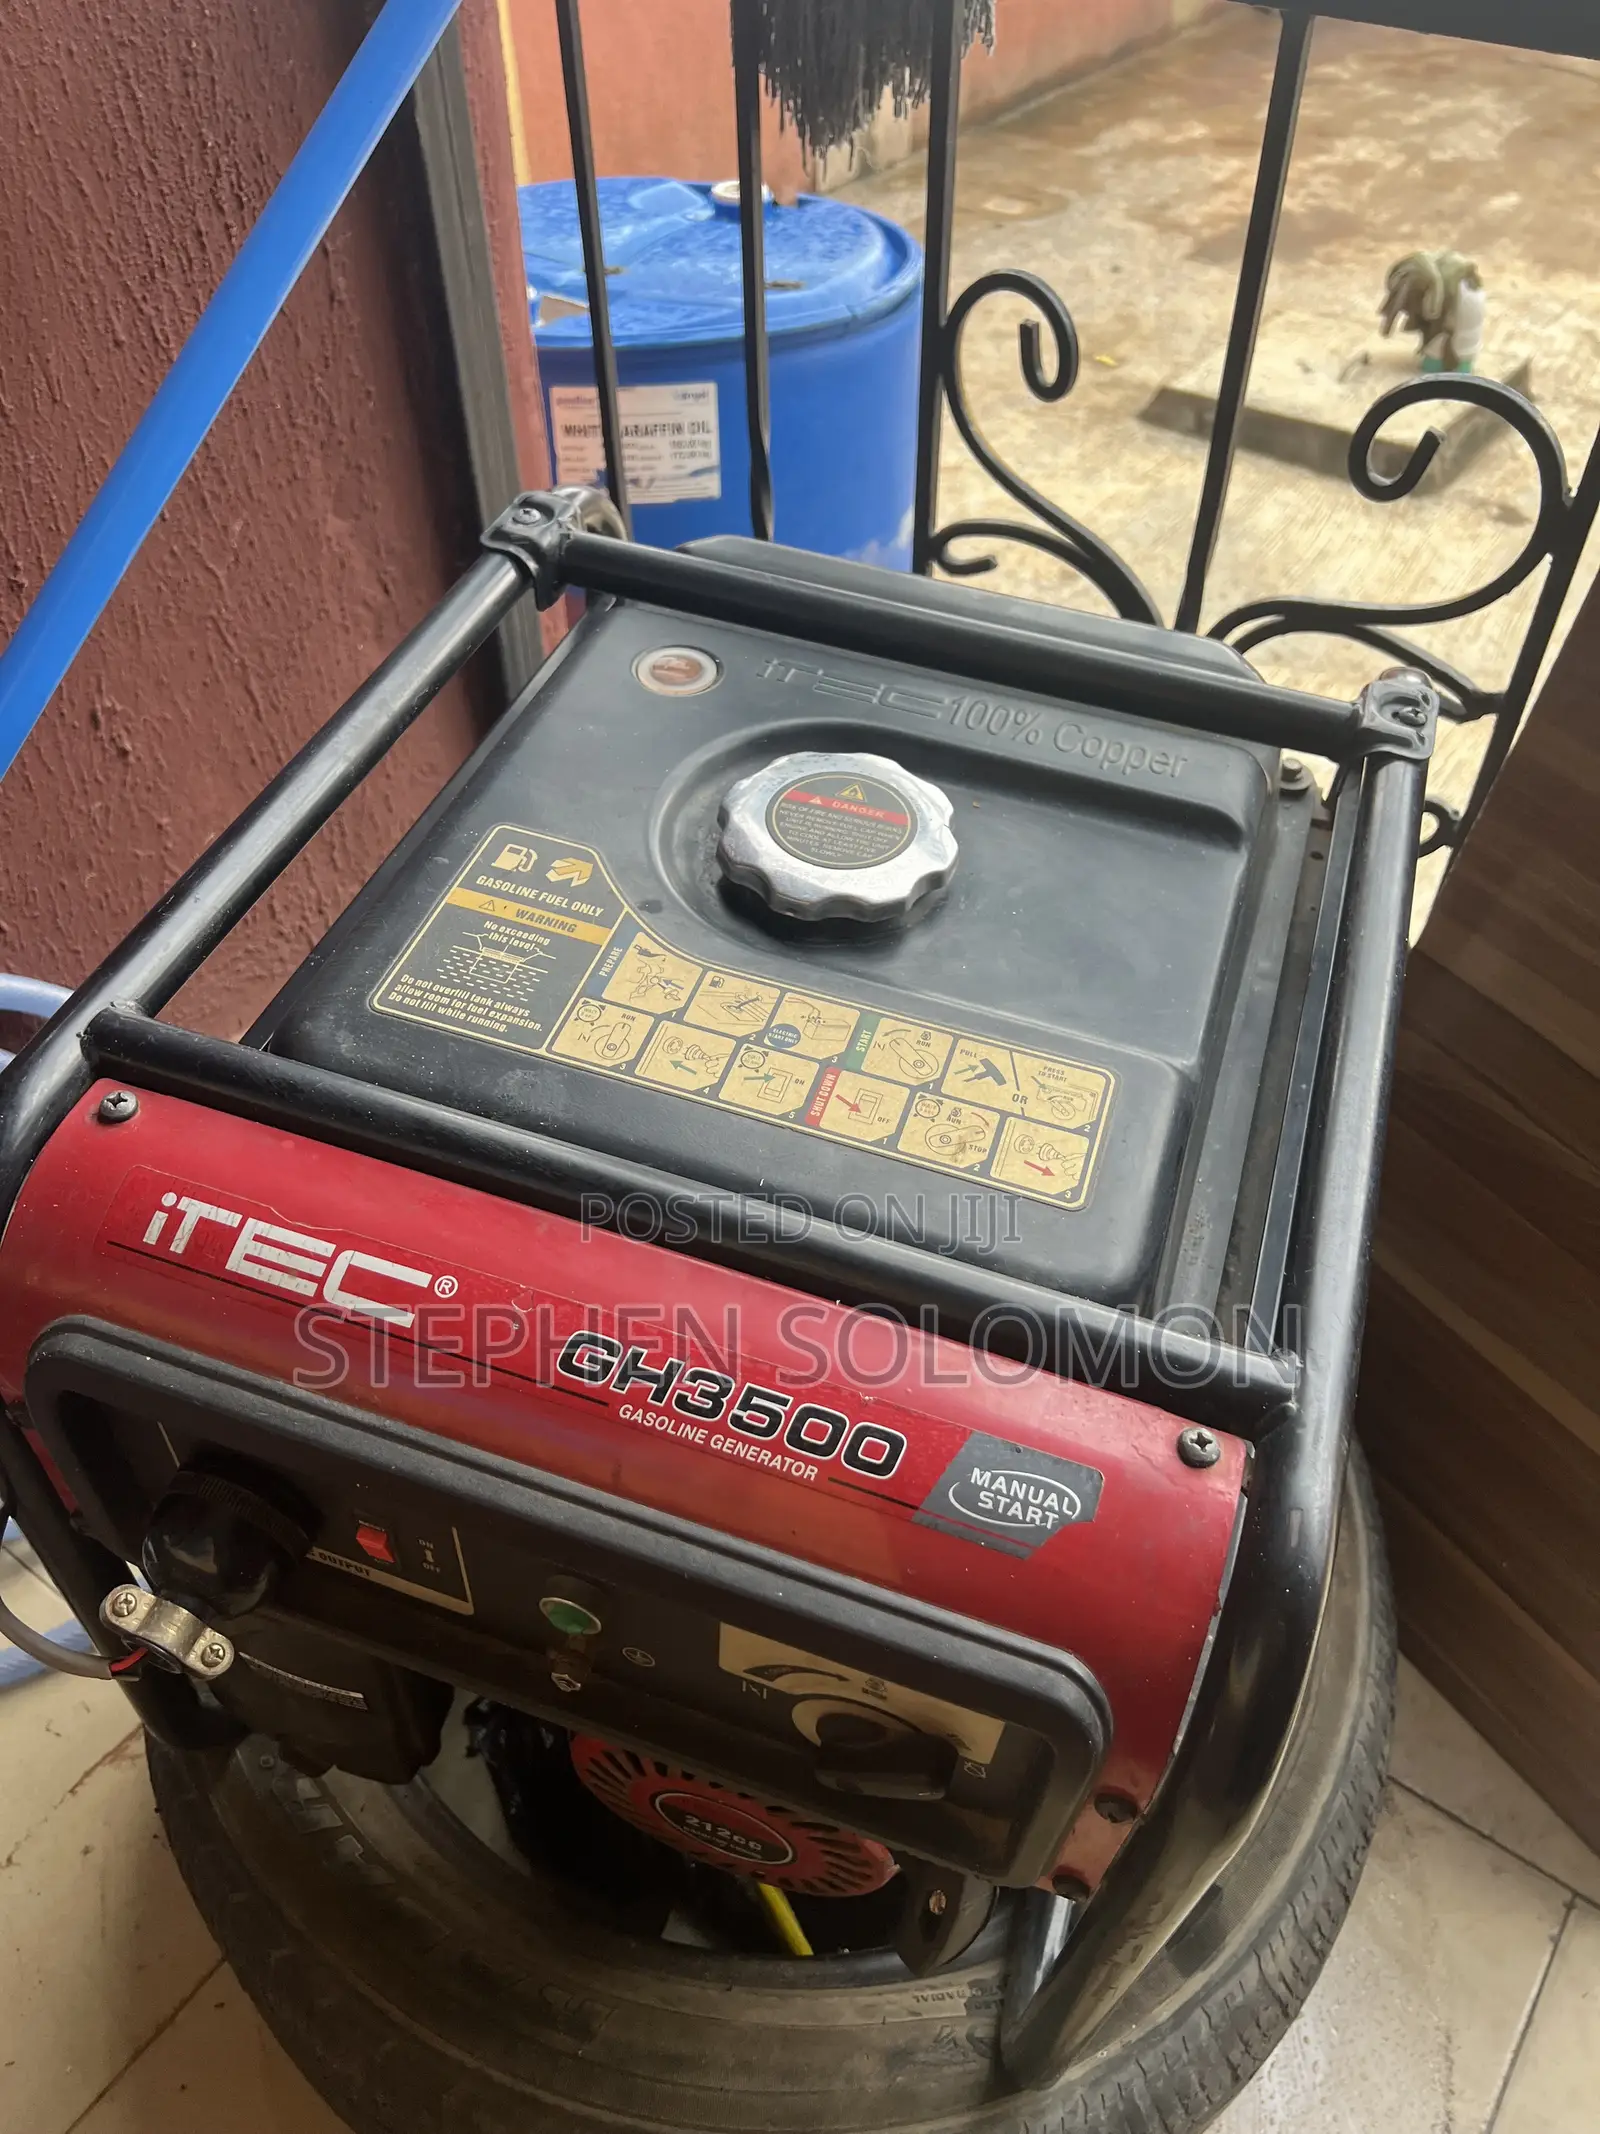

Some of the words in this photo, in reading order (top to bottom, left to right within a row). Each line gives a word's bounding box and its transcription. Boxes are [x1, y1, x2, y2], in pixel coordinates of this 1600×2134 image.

[948, 695, 1042, 746] 100%
[1053, 720, 1188, 779] Copper
[476, 875, 539, 899] GASOLINE
[539, 891, 569, 909] FUEL
[571, 901, 605, 917] ONLY
[515, 907, 578, 933] WARNING
[483, 920, 498, 931] No
[498, 924, 551, 946] exceeding
[488, 931, 507, 944] this
[509, 937, 535, 952] level
[598, 945, 624, 978] PREPARE
[400, 974, 413, 985] Do
[414, 977, 433, 990] not
[433, 983, 471, 1000] overfill
[470, 993, 493, 1008] tank
[493, 999, 532, 1018] always
[388, 991, 403, 1002] Do
[403, 996, 420, 1007] not
[421, 1001, 437, 1012] fill
[437, 1005, 467, 1020] while
[466, 1012, 508, 1033] running.
[394, 983, 424, 997] allow
[423, 991, 451, 1005] room
[451, 998, 467, 1011] for
[467, 1002, 488, 1016] fuel
[488, 1008, 543, 1032] expansion.
[671, 1011, 677, 1019] 1
[620, 1012, 637, 1022] RUN
[749, 1033, 756, 1041] 2
[855, 1029, 872, 1053] START
[915, 1039, 932, 1049] RUN
[959, 1048, 979, 1060] PULL
[1043, 1066, 1065, 1076] PRESS
[703, 1087, 709, 1095] 4
[794, 1078, 805, 1087] ON
[817, 1072, 836, 1100] DOWN
[928, 1082, 934, 1090] 1
[810, 1096, 826, 1118] SHUT
[1011, 1093, 1029, 1106] OR
[788, 1111, 795, 1119] 5
[877, 1116, 891, 1125] OFF
[946, 1116, 962, 1126] RUN
[1084, 1124, 1091, 1132] 2
[968, 1144, 988, 1155] STOP
[973, 1163, 980, 1171] 2
[1065, 1190, 1072, 1198] 3
[556, 1329, 908, 1480] GH3500
[618, 1404, 709, 1445] GASOLINE
[709, 1433, 819, 1481] GENERATOR
[970, 1466, 1073, 1516] MANUAL
[977, 1490, 1060, 1530] START
[318, 1551, 372, 1577] OUTPUT
